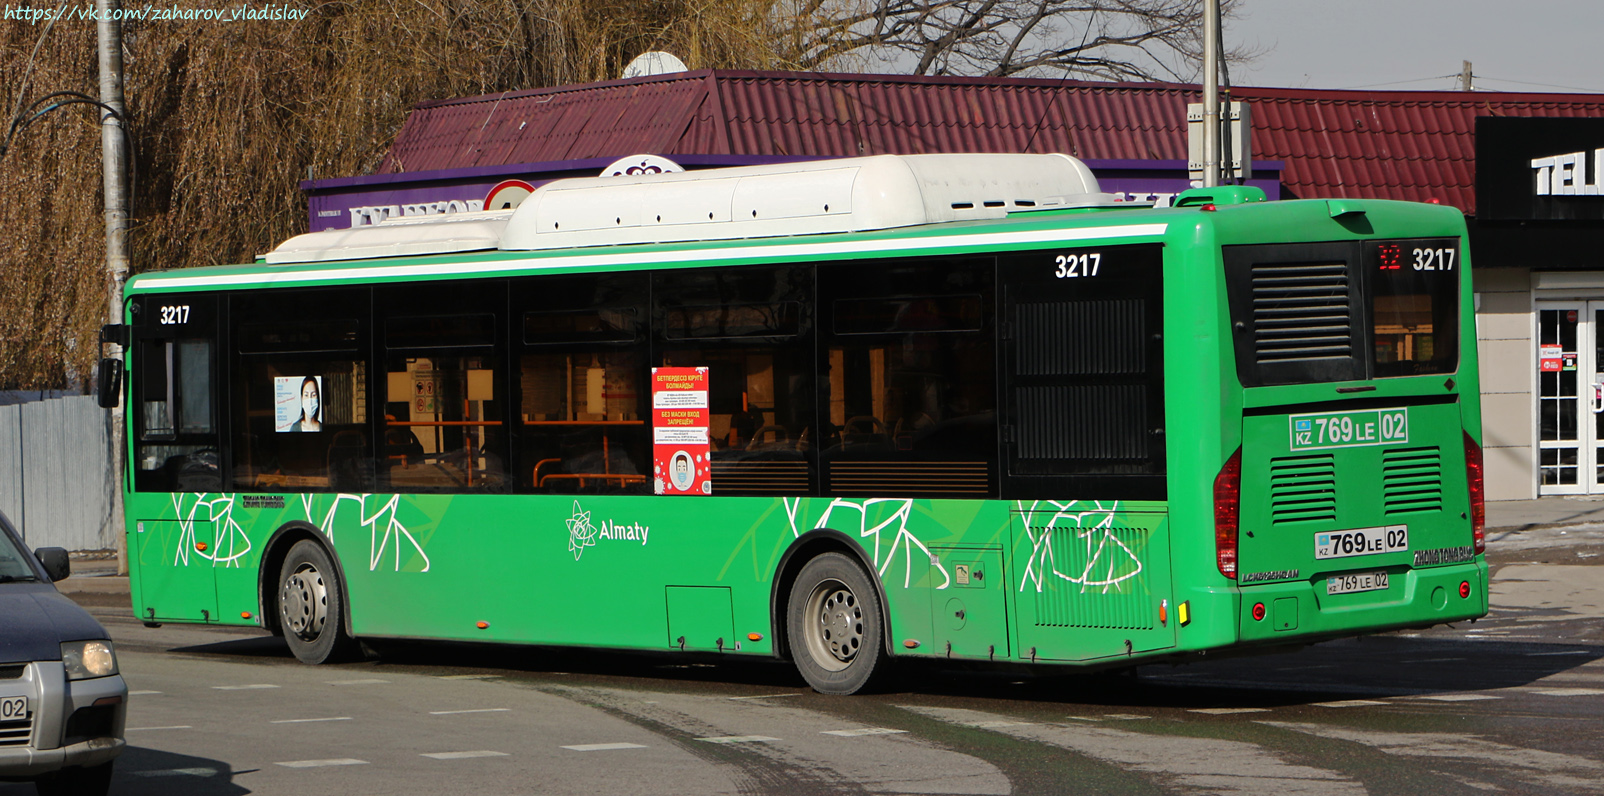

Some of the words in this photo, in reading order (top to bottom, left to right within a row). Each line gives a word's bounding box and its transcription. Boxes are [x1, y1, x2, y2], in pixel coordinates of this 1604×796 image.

[1055, 253, 1101, 279] 3217
[1379, 245, 1400, 270] 32
[1412, 248, 1455, 271] 3217
[160, 305, 190, 325] 3217
[1296, 432, 1312, 445] KZ
[1315, 416, 1353, 444] 769
[1355, 422, 1375, 441] LE
[1382, 413, 1405, 439] 02
[599, 519, 649, 546] Almaty
[1330, 532, 1366, 555] 769
[1367, 539, 1383, 552] LE
[1387, 529, 1406, 548] 02
[1319, 548, 1328, 556] KZ
[1413, 549, 1440, 566] ZHONG
[1439, 546, 1459, 565] TONG
[1338, 575, 1358, 591] 769
[1360, 577, 1372, 589] LE
[1375, 572, 1388, 587] 02
[2, 699, 25, 717] 02
